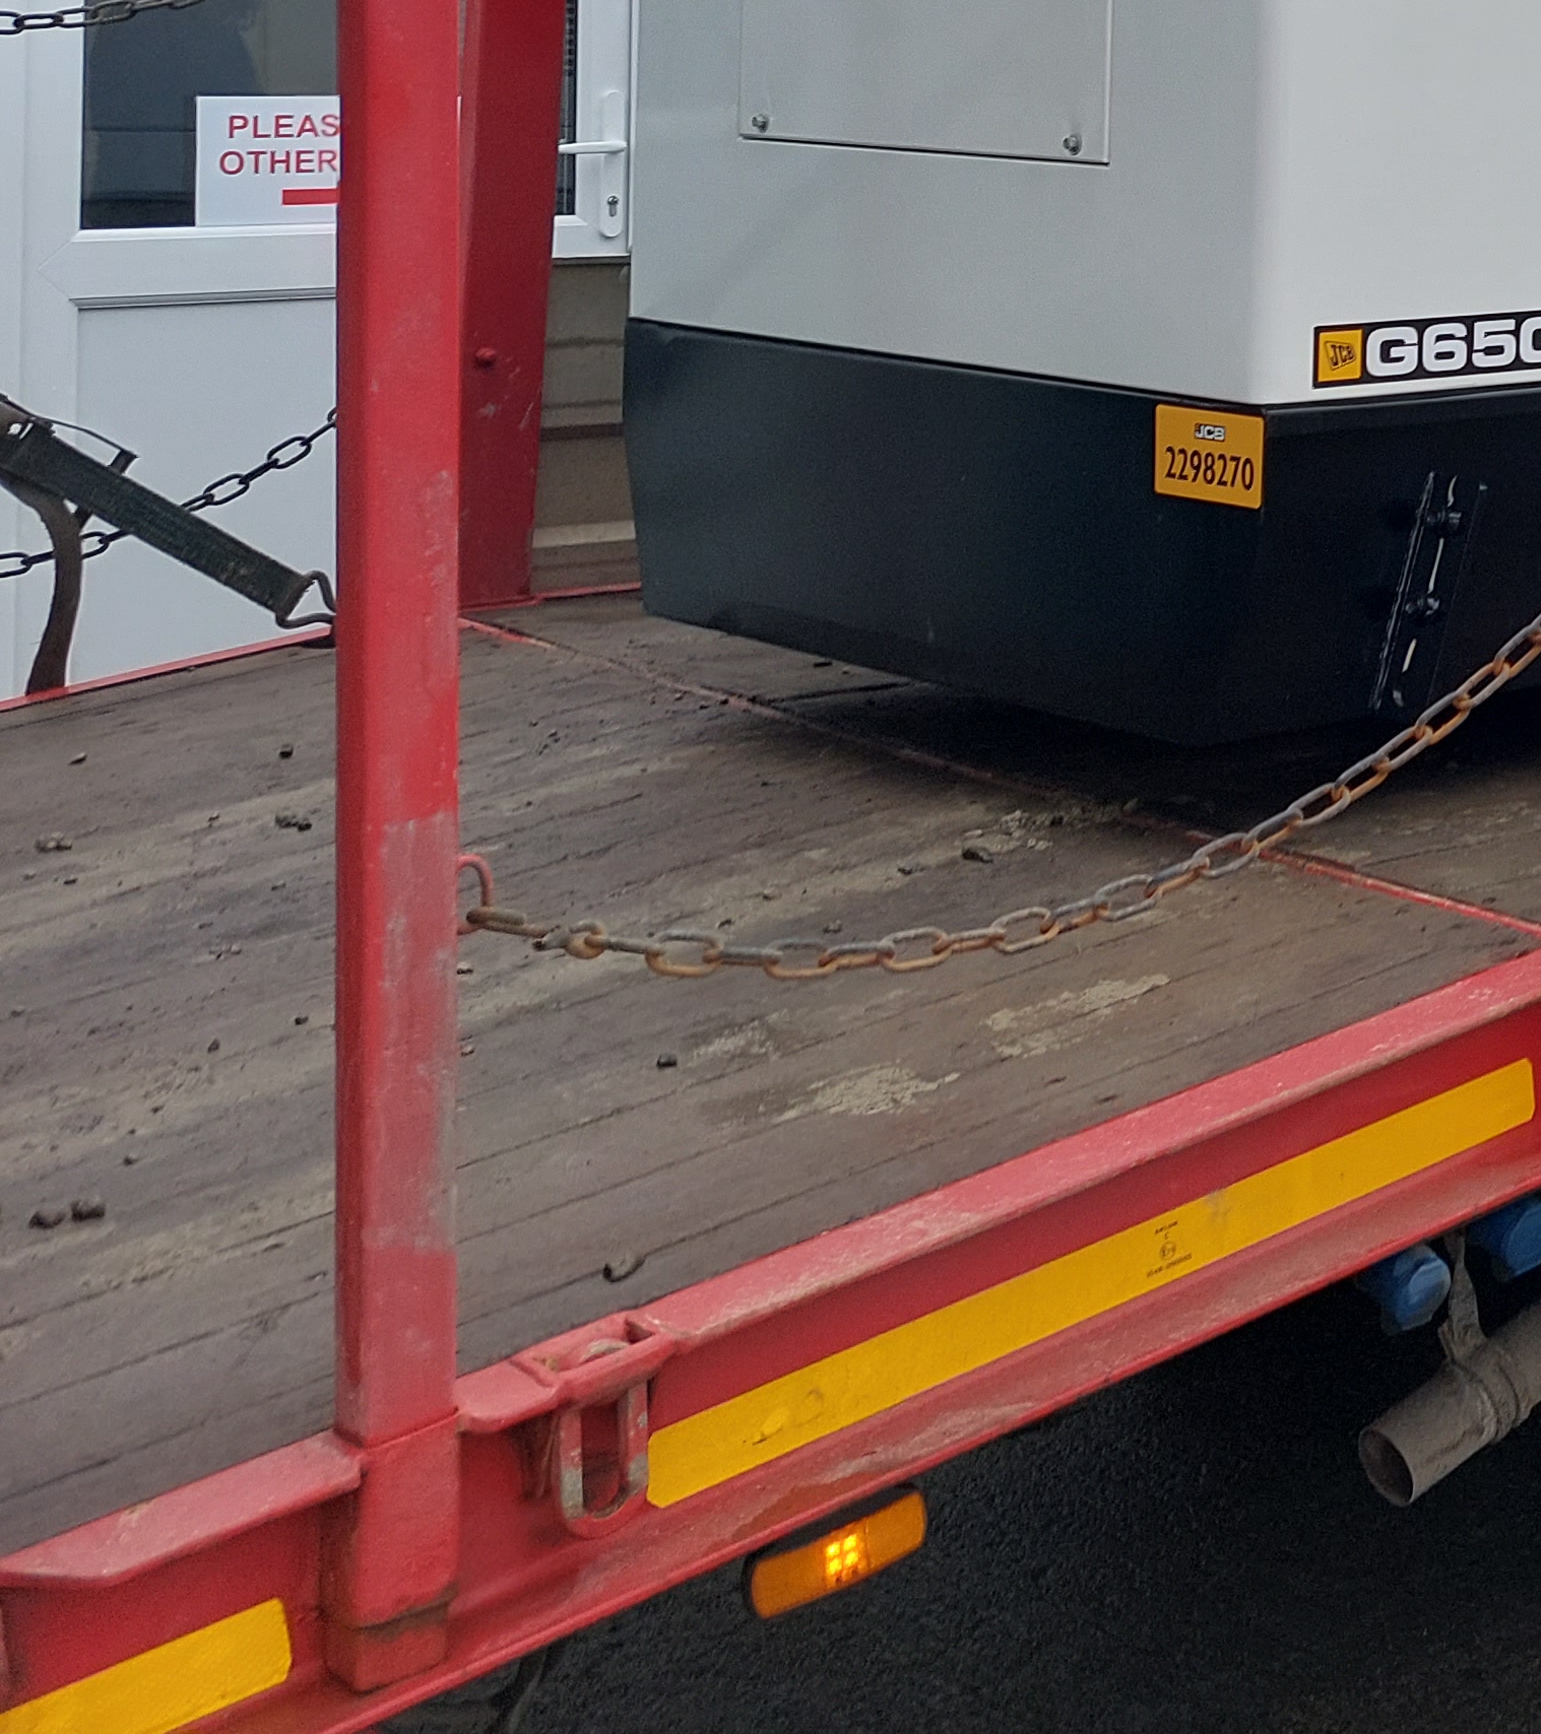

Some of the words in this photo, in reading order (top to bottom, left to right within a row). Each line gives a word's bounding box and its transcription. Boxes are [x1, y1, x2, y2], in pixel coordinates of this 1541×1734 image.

[219, 150, 337, 175] OTHER
[1195, 423, 1225, 441] JCB
[1165, 445, 1254, 491] 2298270
